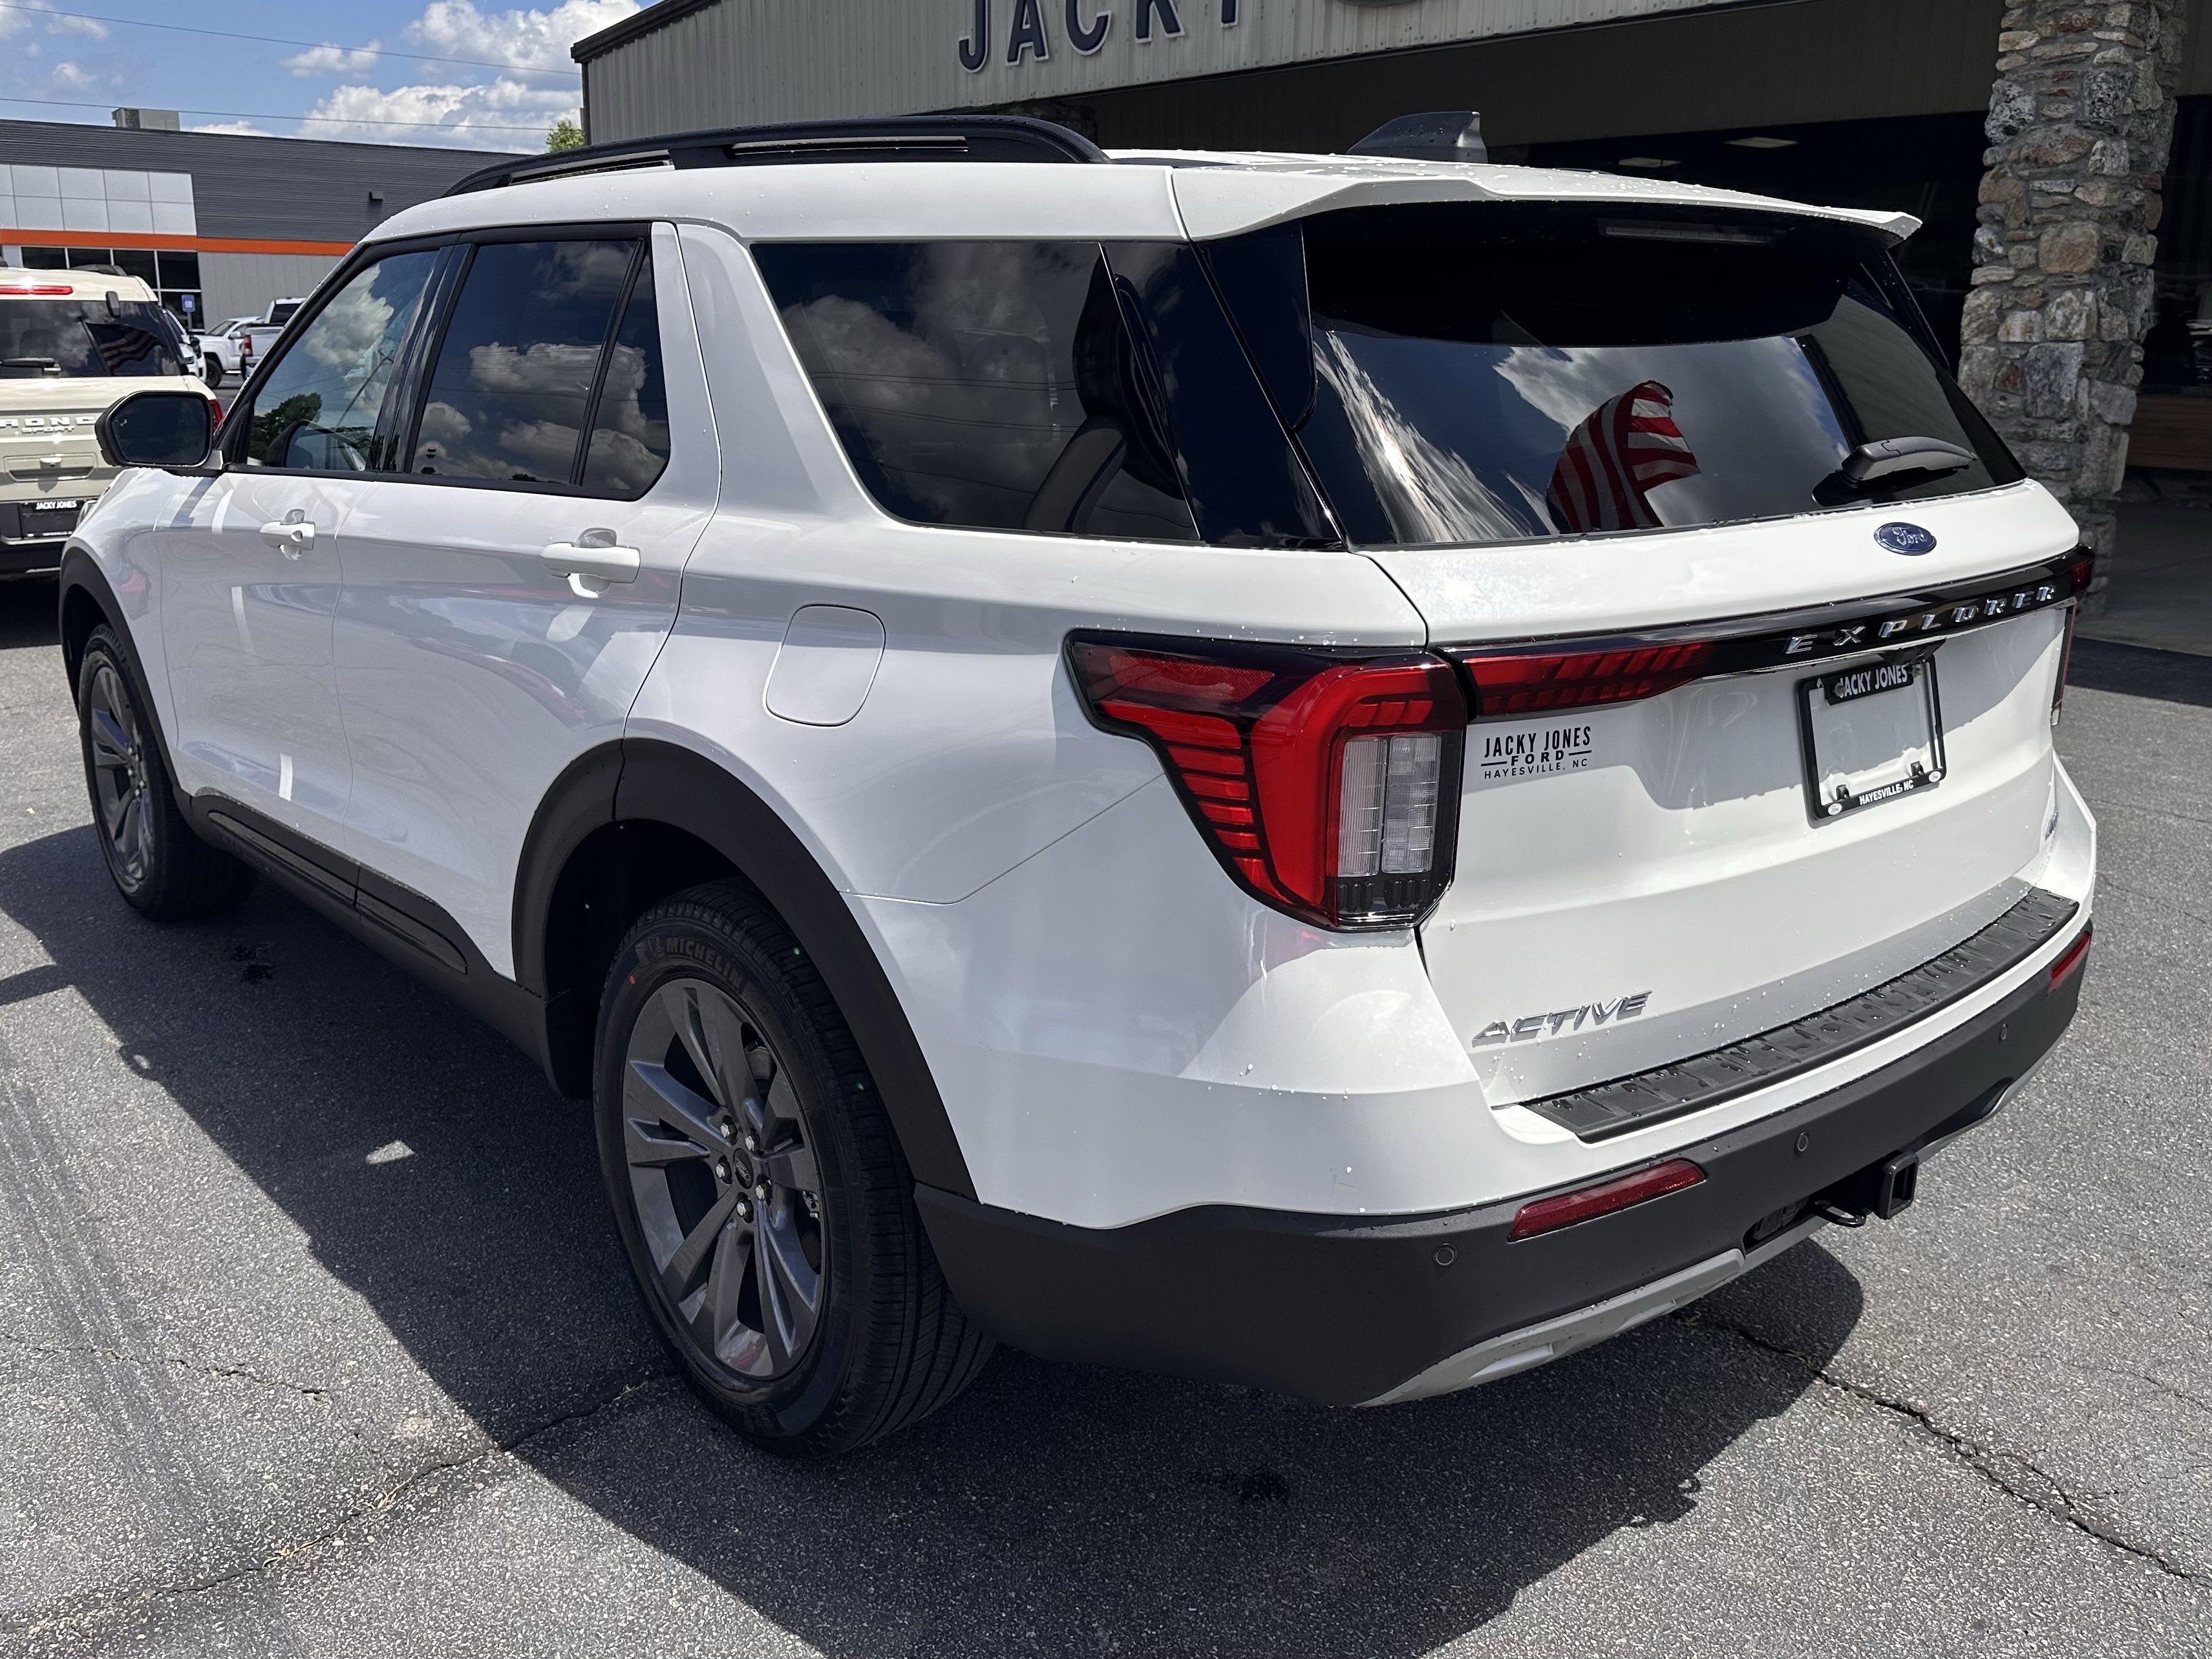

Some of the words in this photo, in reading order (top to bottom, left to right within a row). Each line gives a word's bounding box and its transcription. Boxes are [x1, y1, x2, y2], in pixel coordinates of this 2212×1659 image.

[36, 501, 56, 509] JACKY
[56, 500, 78, 509] JONES
[1891, 527, 1928, 546] Ford
[1785, 584, 2058, 654] EXPLORER
[1875, 665, 1908, 690] JONES
[1484, 733, 1537, 758] JACKY
[1544, 726, 1591, 751] JONES
[1484, 762, 1566, 780] HAYESVILLE,
[1572, 758, 1588, 769] NC
[1511, 750, 1564, 767] FORD
[1859, 784, 1903, 806] HAYESVILLE,
[1904, 780, 1914, 791] NC
[666, 937, 743, 988] MICHELIN
[1471, 989, 1653, 1041] ACTIVE
